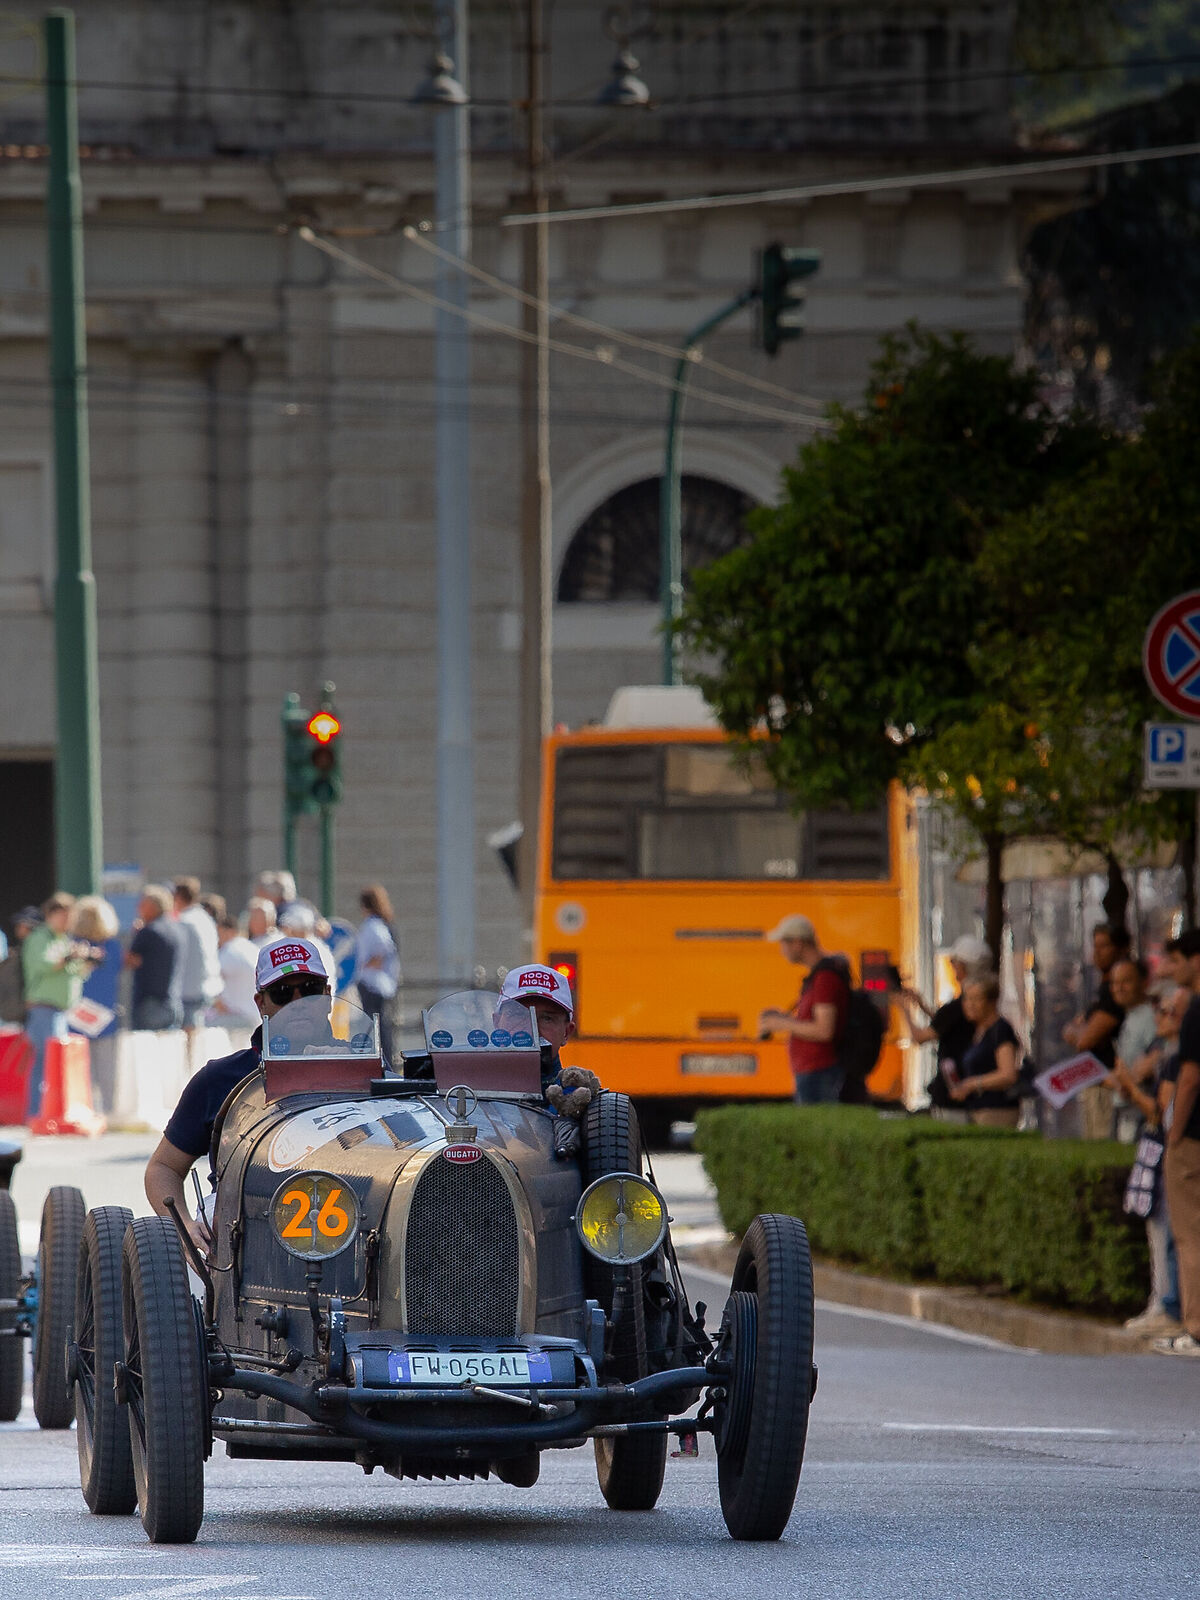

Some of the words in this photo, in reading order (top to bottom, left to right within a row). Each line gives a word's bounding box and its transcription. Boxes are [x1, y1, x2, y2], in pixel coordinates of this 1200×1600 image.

[1157, 731, 1181, 762] P
[274, 946, 300, 956] 1000
[274, 952, 304, 964] MIGLIA
[524, 972, 550, 980] 1000
[521, 979, 551, 988] MIGLIA
[446, 1150, 480, 1158] BUGATTI
[281, 1189, 349, 1238] 26
